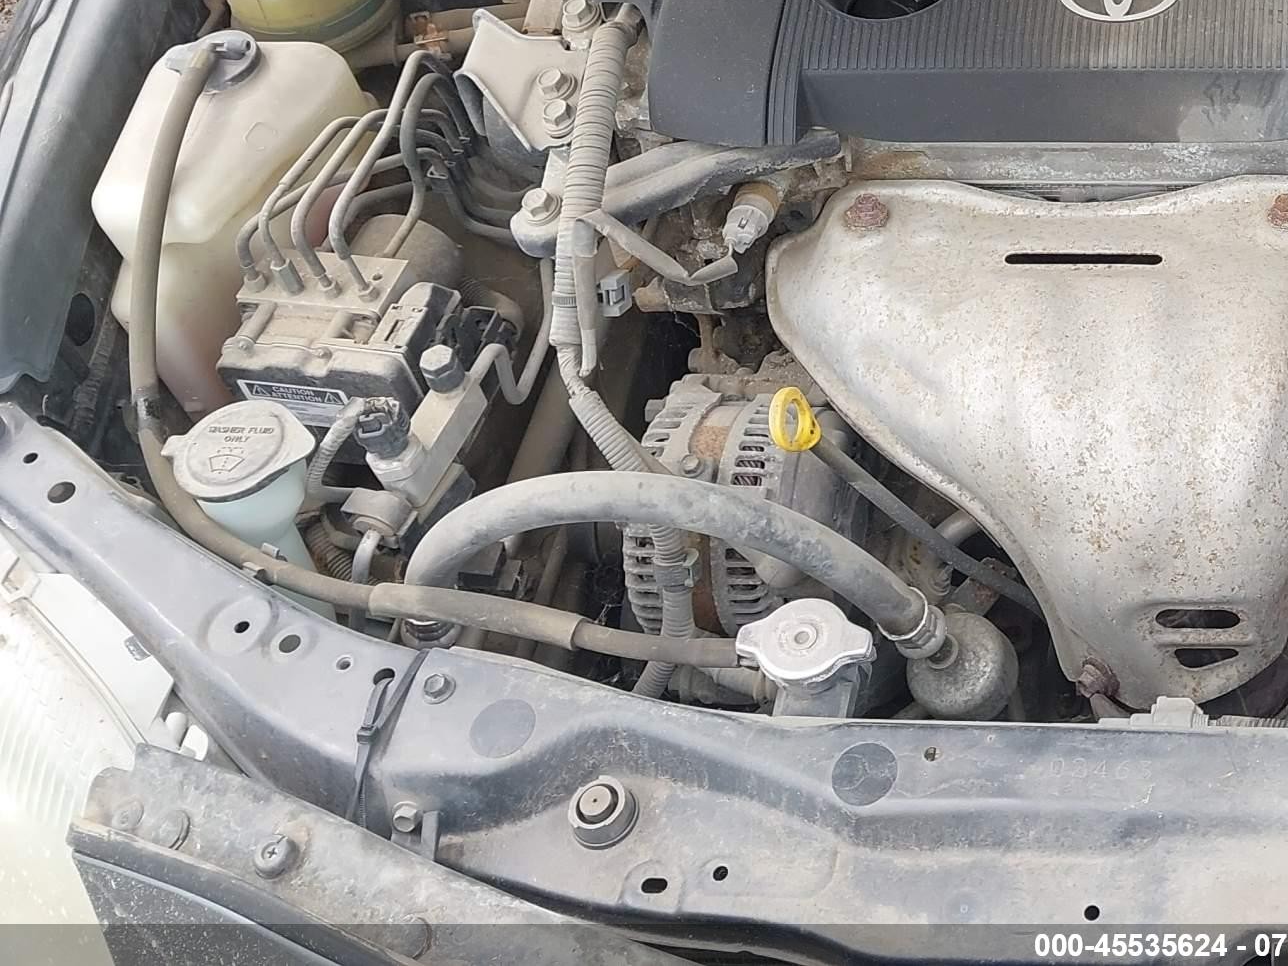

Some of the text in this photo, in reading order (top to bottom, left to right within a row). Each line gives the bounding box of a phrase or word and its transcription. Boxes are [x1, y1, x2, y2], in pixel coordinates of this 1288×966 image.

[272, 386, 315, 396] CAUTION
[271, 392, 322, 403] ATTENTION
[208, 426, 274, 435] WASHER FLUID
